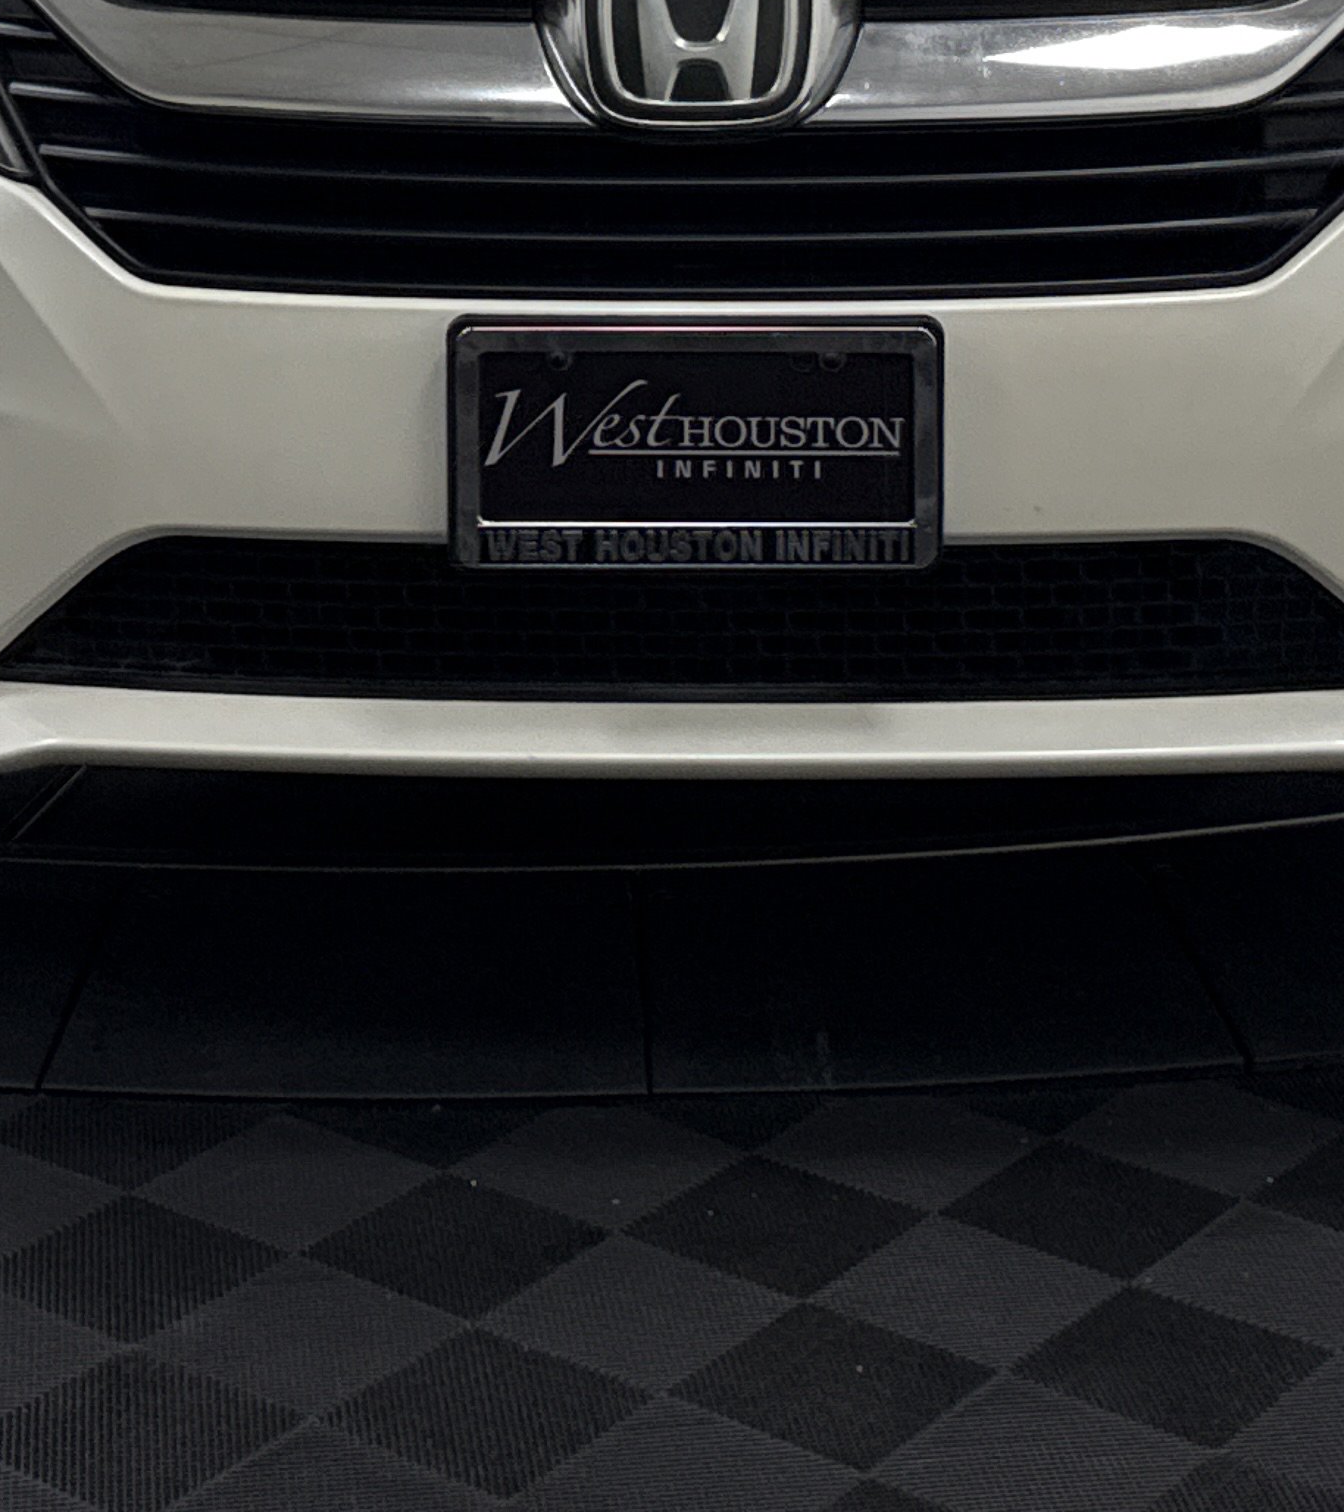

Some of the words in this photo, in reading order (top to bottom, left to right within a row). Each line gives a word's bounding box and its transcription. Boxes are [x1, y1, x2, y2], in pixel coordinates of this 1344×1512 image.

[682, 416, 905, 449] HOUSTON
[657, 459, 822, 479] INFINITI
[487, 529, 582, 561] WEST
[596, 529, 764, 561] HOUSTON
[775, 529, 910, 561] INFINITI
